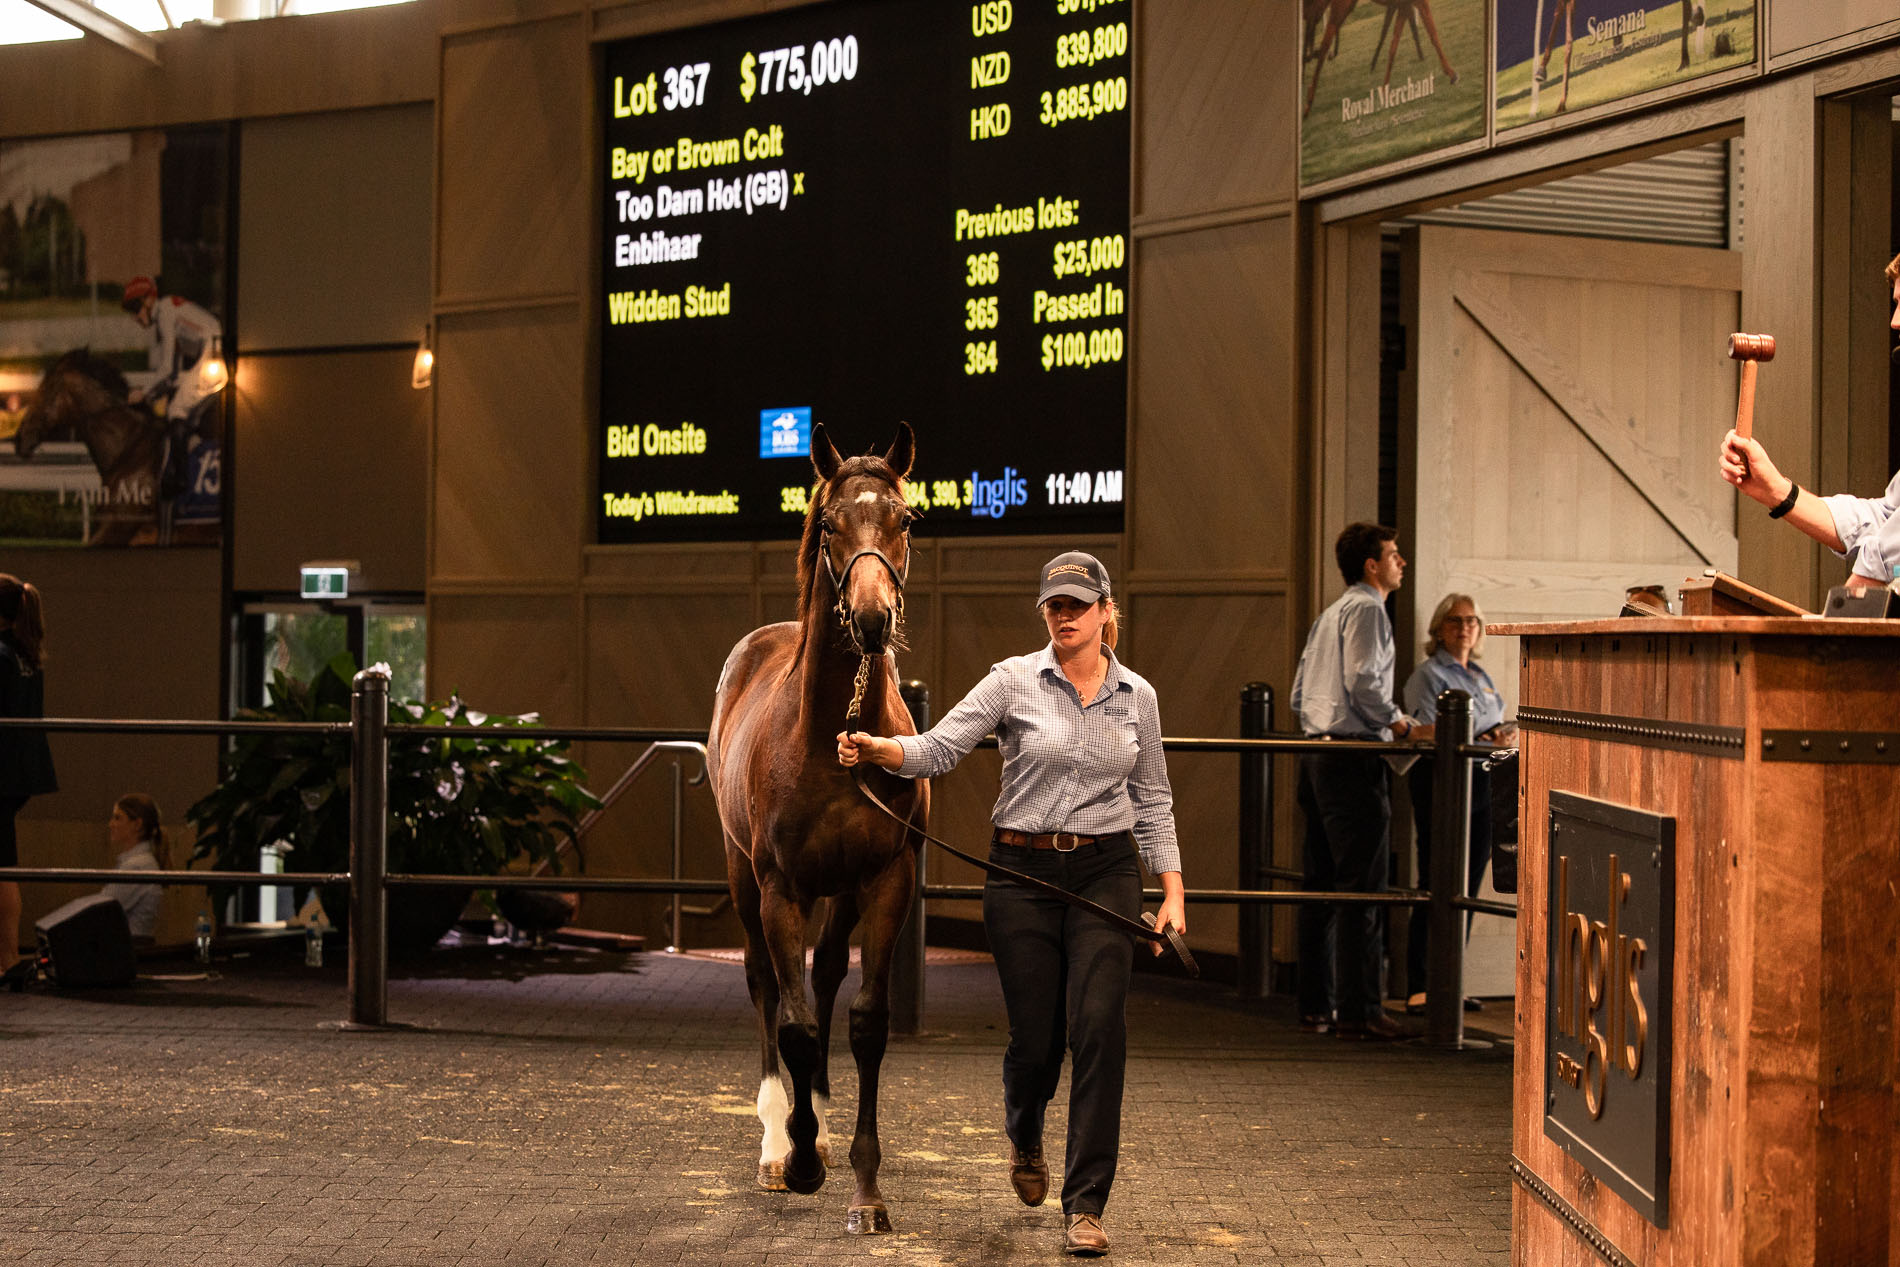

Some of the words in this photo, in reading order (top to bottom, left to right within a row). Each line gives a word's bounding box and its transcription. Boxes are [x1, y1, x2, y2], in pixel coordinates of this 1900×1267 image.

[973, 0, 1012, 37] USD
[1587, 8, 1645, 46] Semana
[1056, 23, 1127, 68] 839,800
[615, 73, 657, 118] Lot
[663, 63, 710, 110] 367
[740, 35, 858, 103] $775,000
[972, 51, 1010, 89] NZD
[1040, 77, 1127, 127] 3,885,900
[1342, 88, 1374, 124] Royal
[1377, 73, 1434, 110] Merchant
[971, 104, 1011, 140] HKD
[612, 148, 649, 184] Bay
[652, 147, 675, 173] or
[678, 138, 739, 170] Brown
[744, 125, 783, 160] Colt
[616, 191, 653, 222] Too
[657, 186, 703, 218] Darn
[708, 178, 742, 211] Hot
[745, 169, 788, 215] (GB)
[793, 173, 804, 195] x
[956, 204, 1034, 241] Previous
[1038, 196, 1079, 229] lots:
[616, 231, 702, 267] Enbihaar
[966, 252, 999, 286] 366
[1053, 235, 1124, 279] $25,000
[609, 290, 680, 324] Widden
[685, 283, 730, 318] Stud
[965, 296, 998, 331] 365
[1034, 283, 1102, 323] Passed
[1105, 282, 1123, 315] In
[965, 341, 998, 375] 364
[1042, 328, 1123, 371] $100,000
[607, 425, 640, 457] Bid
[643, 422, 706, 456] Onsite
[116, 478, 152, 505] Me
[604, 492, 654, 521] Today's
[971, 467, 1027, 518] Inglis
[1046, 472, 1091, 504] 11:40
[1093, 471, 1122, 502] AM
[1557, 853, 1648, 1121] Inglis
